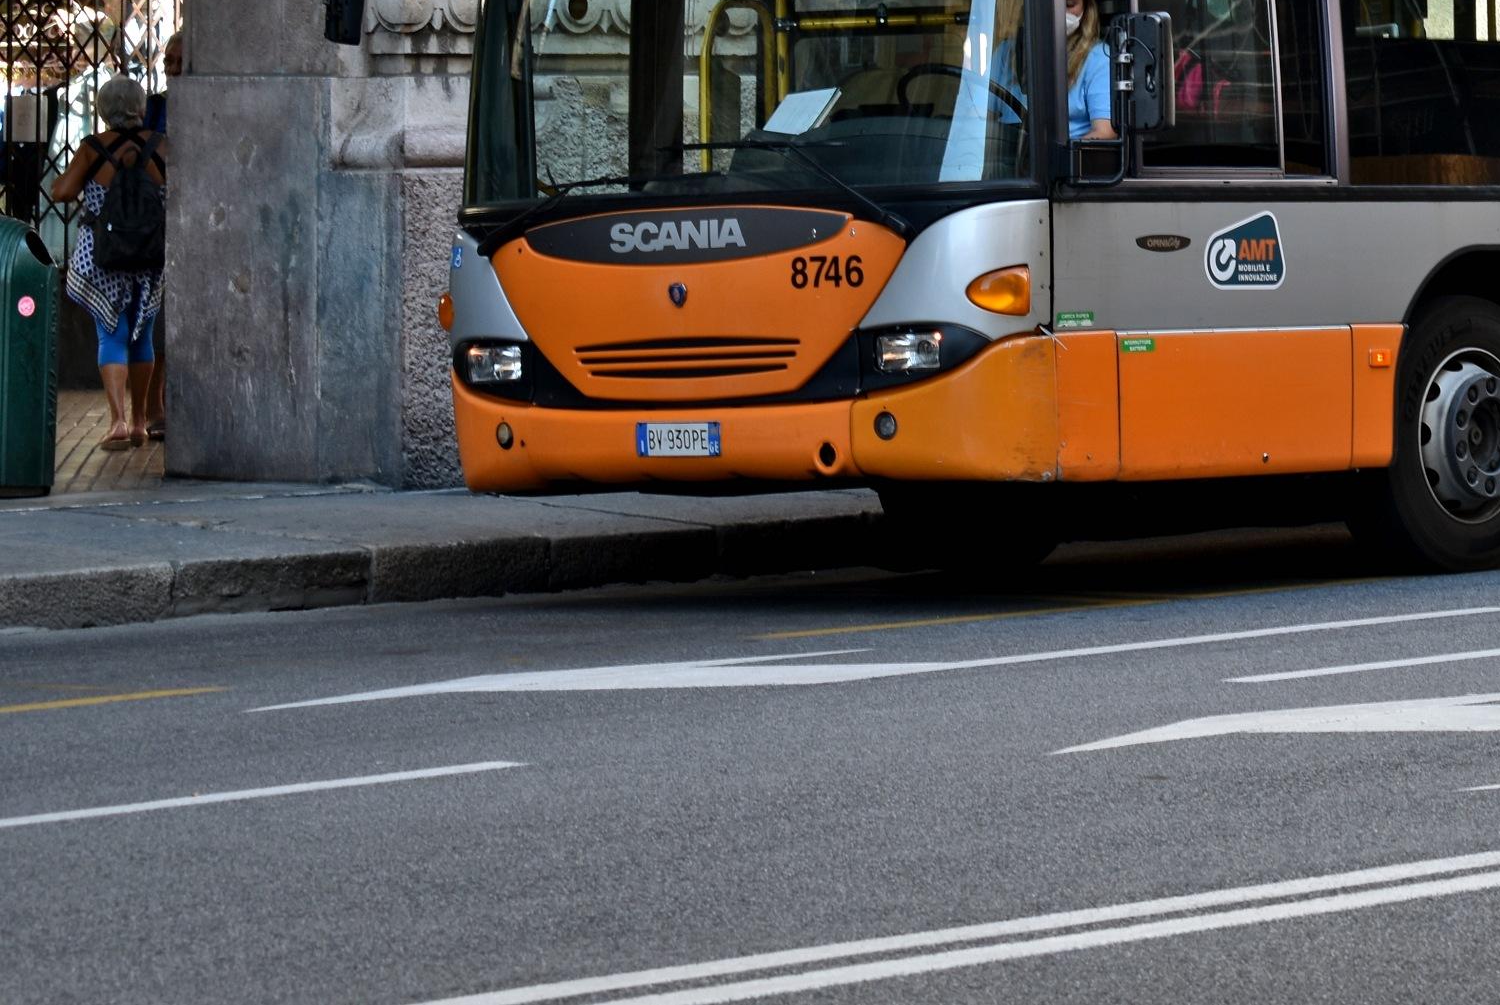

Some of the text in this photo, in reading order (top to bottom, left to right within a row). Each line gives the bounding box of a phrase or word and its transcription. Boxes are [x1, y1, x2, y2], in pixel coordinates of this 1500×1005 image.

[609, 218, 746, 254] SCANIA
[1238, 238, 1276, 261] AMT
[790, 255, 864, 289] 8746
[1238, 273, 1278, 282] INNOVAZIONE
[648, 429, 663, 450] BV
[667, 429, 708, 450] 930PE
